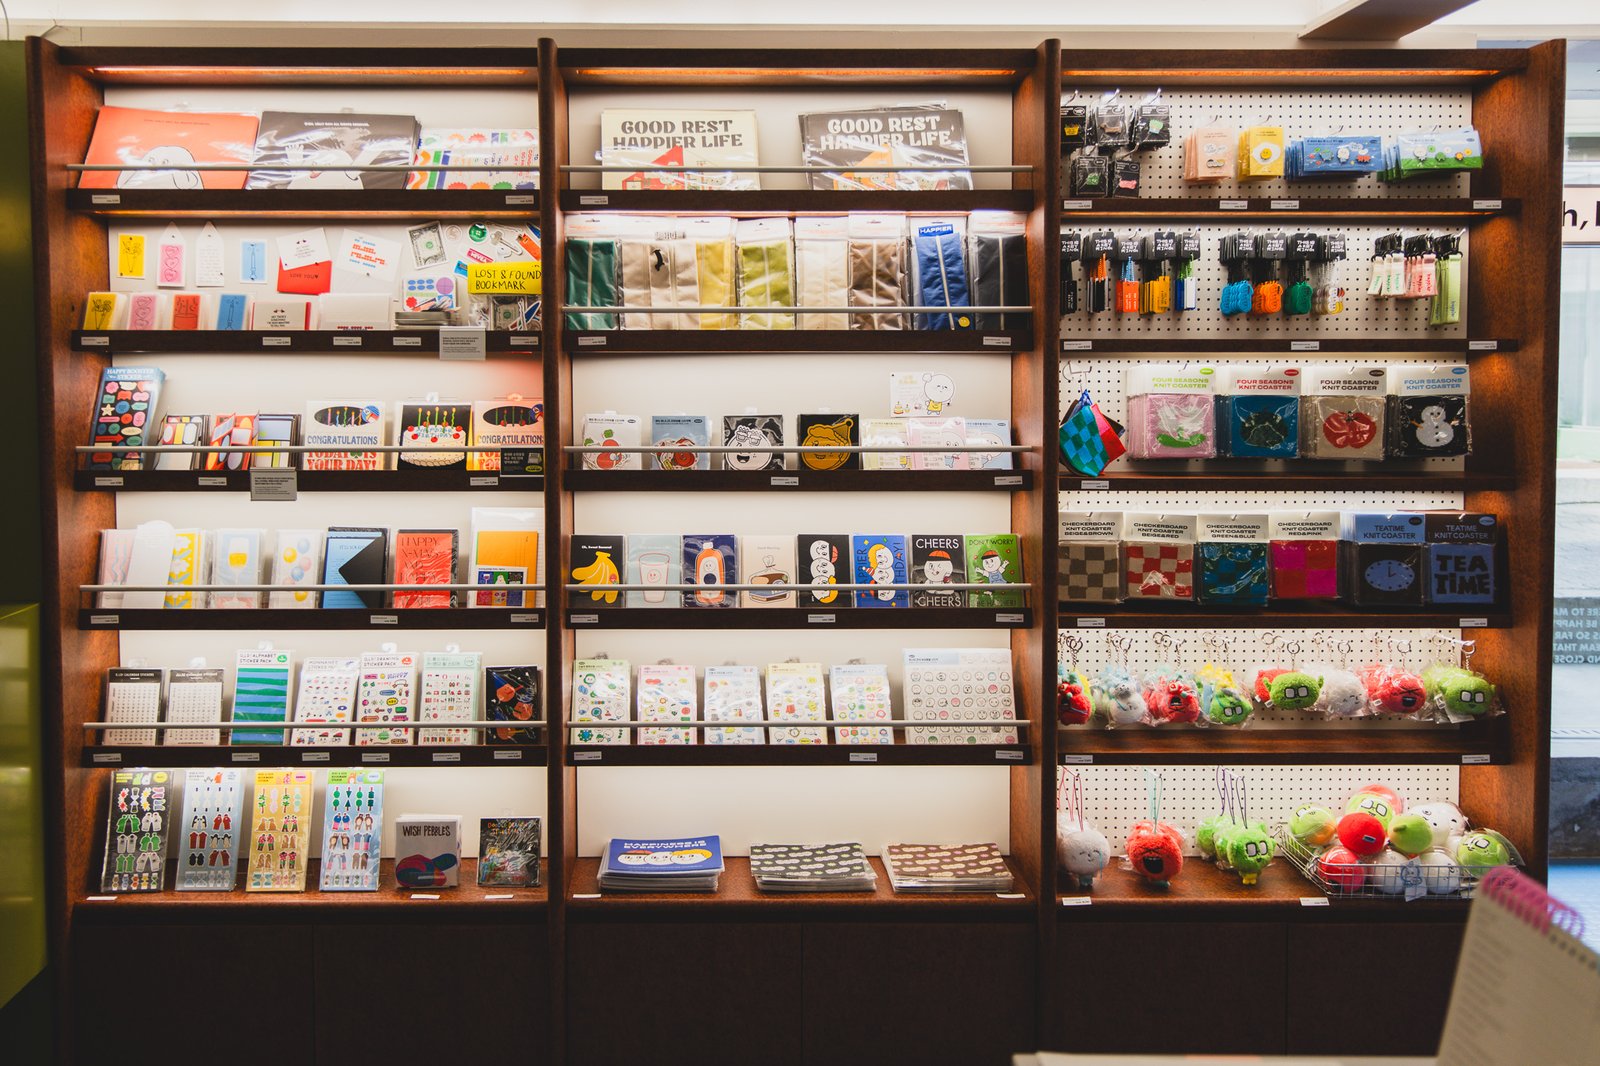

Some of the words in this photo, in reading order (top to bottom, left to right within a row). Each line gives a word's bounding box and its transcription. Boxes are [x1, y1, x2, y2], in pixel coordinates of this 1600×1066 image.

[621, 120, 676, 134] GOOD
[682, 120, 733, 133] REST
[828, 118, 883, 133] GOOD
[888, 116, 941, 132] REST
[613, 136, 696, 150] HAPPIER
[701, 134, 743, 148] LIFE
[909, 131, 952, 147] LIFE
[920, 225, 953, 234] HAPPIER
[475, 269, 497, 279] LOST
[501, 269, 508, 279] &
[509, 270, 542, 280] FOUND
[475, 280, 526, 290] BOOKMARK
[307, 435, 378, 445] CONGRATULATIONS
[307, 459, 346, 470] YOUR
[350, 459, 377, 470] DAY!
[916, 538, 960, 549] CHEERS
[1436, 555, 1489, 572] TEA
[1434, 573, 1490, 595] TIME
[917, 596, 962, 607] CHEERS
[402, 825, 422, 836] WISH
[424, 825, 451, 836] PEBBLES
